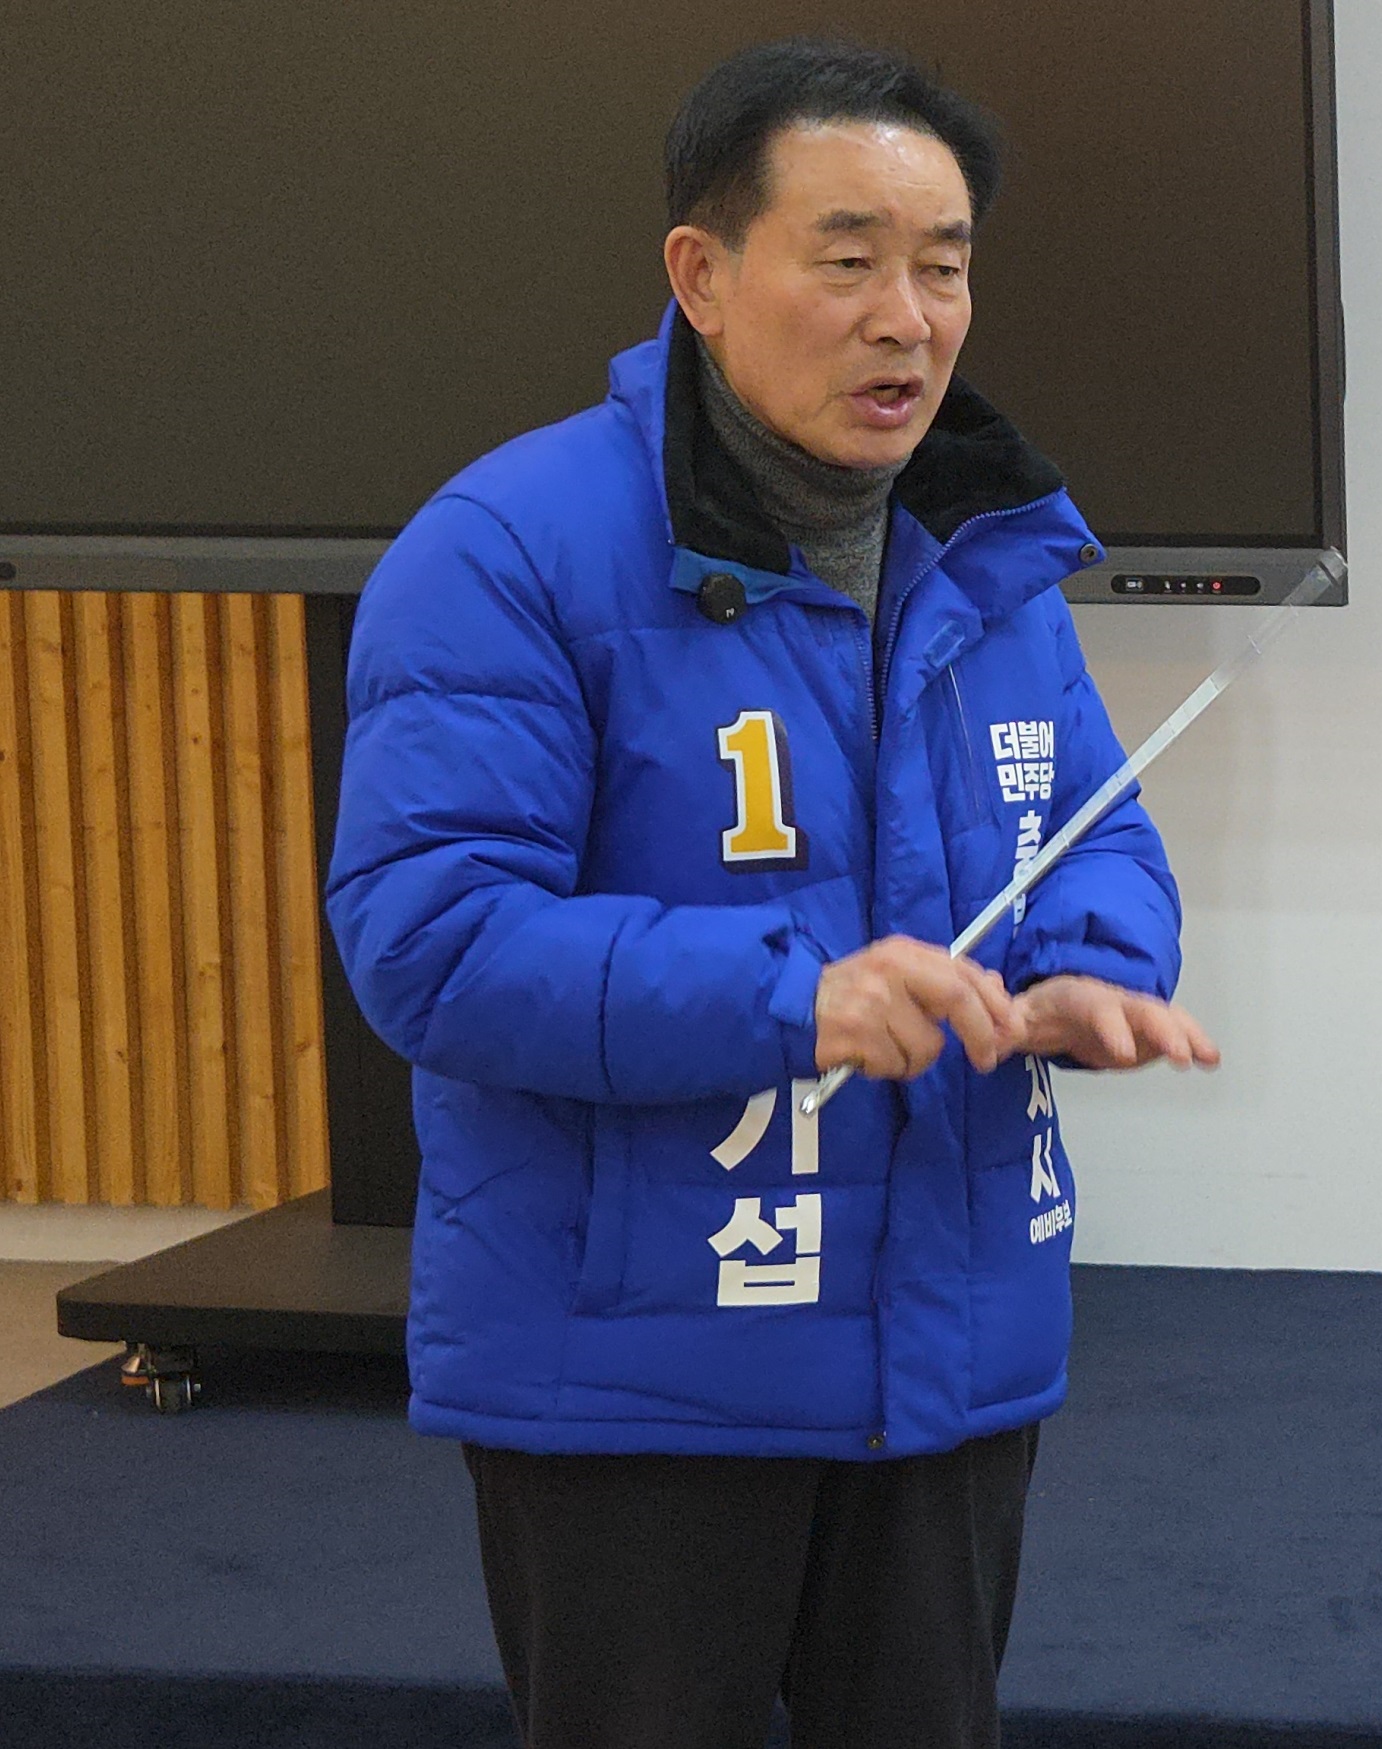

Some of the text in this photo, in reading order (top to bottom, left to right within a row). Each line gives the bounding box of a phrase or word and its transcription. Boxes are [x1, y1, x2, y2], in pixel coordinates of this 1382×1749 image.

[989, 720, 1054, 759] 더불어
[717, 710, 802, 868] 1
[996, 762, 1055, 803] 민주당
[1029, 1199, 1073, 1244] 예비후보
